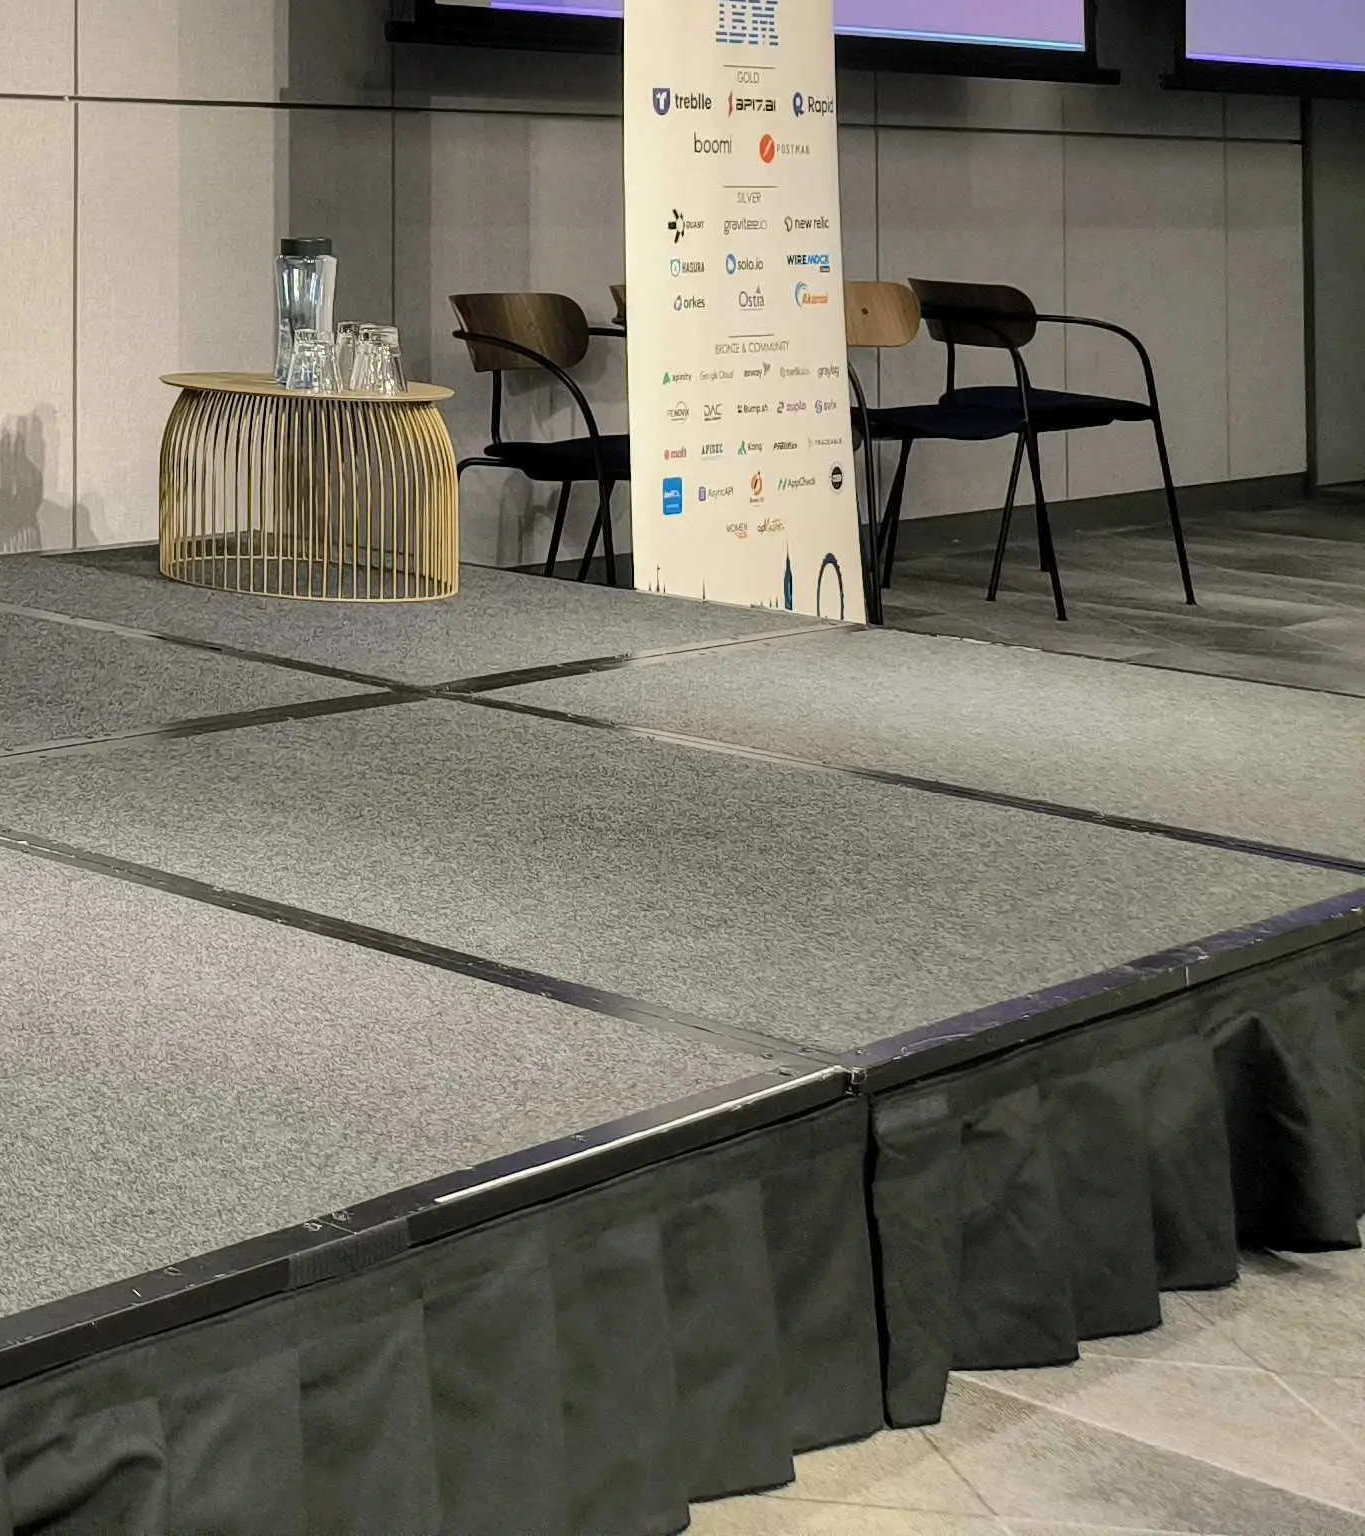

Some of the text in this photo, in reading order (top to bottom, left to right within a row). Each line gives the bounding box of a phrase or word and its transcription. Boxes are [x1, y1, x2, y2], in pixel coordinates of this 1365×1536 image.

[737, 70, 760, 84] GOLD
[674, 92, 712, 111] treblle
[694, 131, 732, 154] boomi
[776, 143, 810, 156] POSTMAN
[737, 192, 761, 204] SILVER
[794, 216, 830, 229] new relic
[737, 257, 764, 271] solo.io
[683, 296, 706, 309] orkes
[749, 341, 789, 354] COMMUNITY
